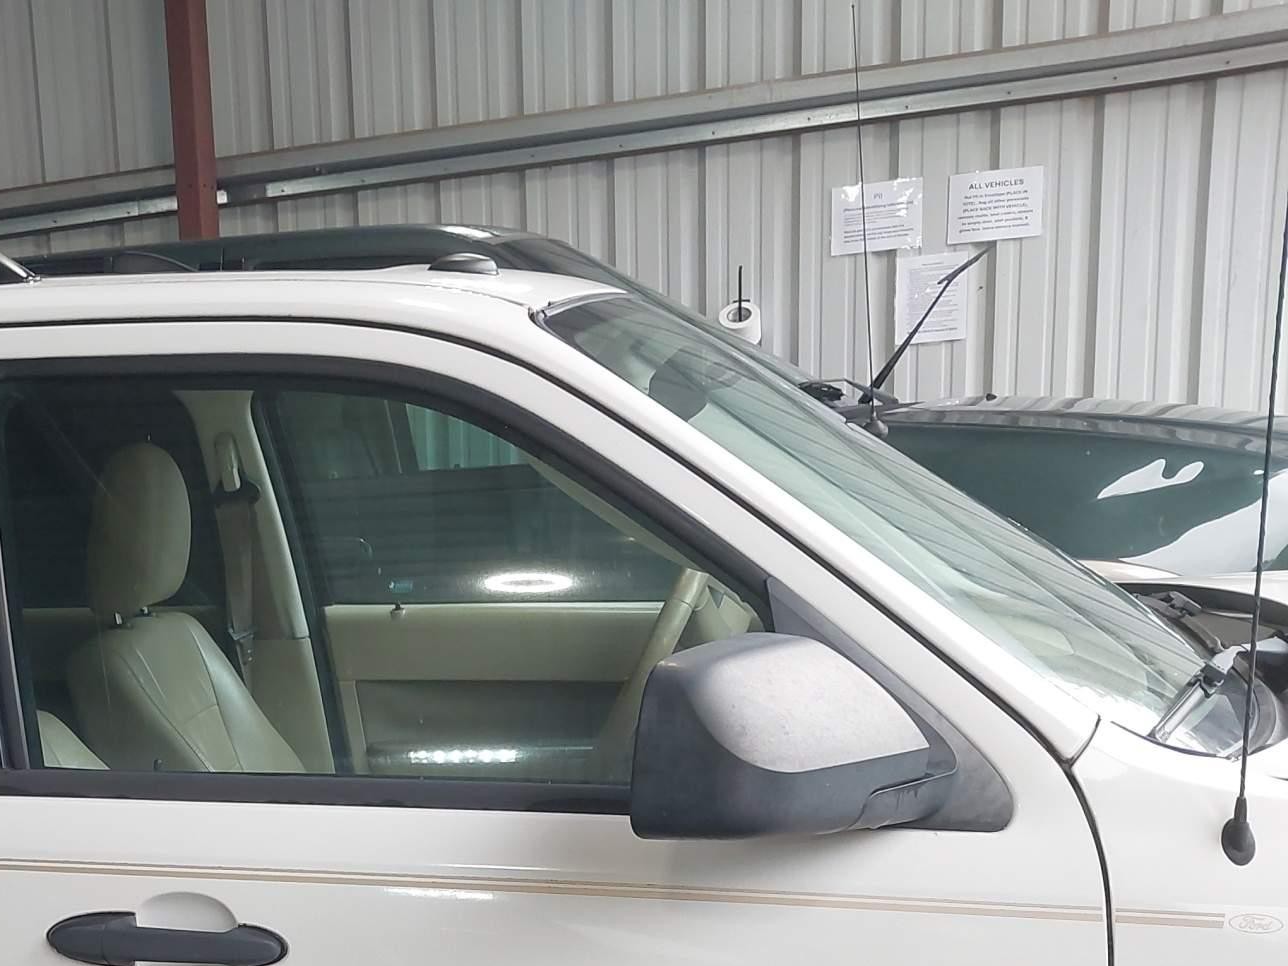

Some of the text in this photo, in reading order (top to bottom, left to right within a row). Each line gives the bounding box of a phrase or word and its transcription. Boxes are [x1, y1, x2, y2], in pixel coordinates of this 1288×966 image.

[968, 178, 1025, 191] ALL VEHICLES
[1238, 915, 1273, 931] Ford
